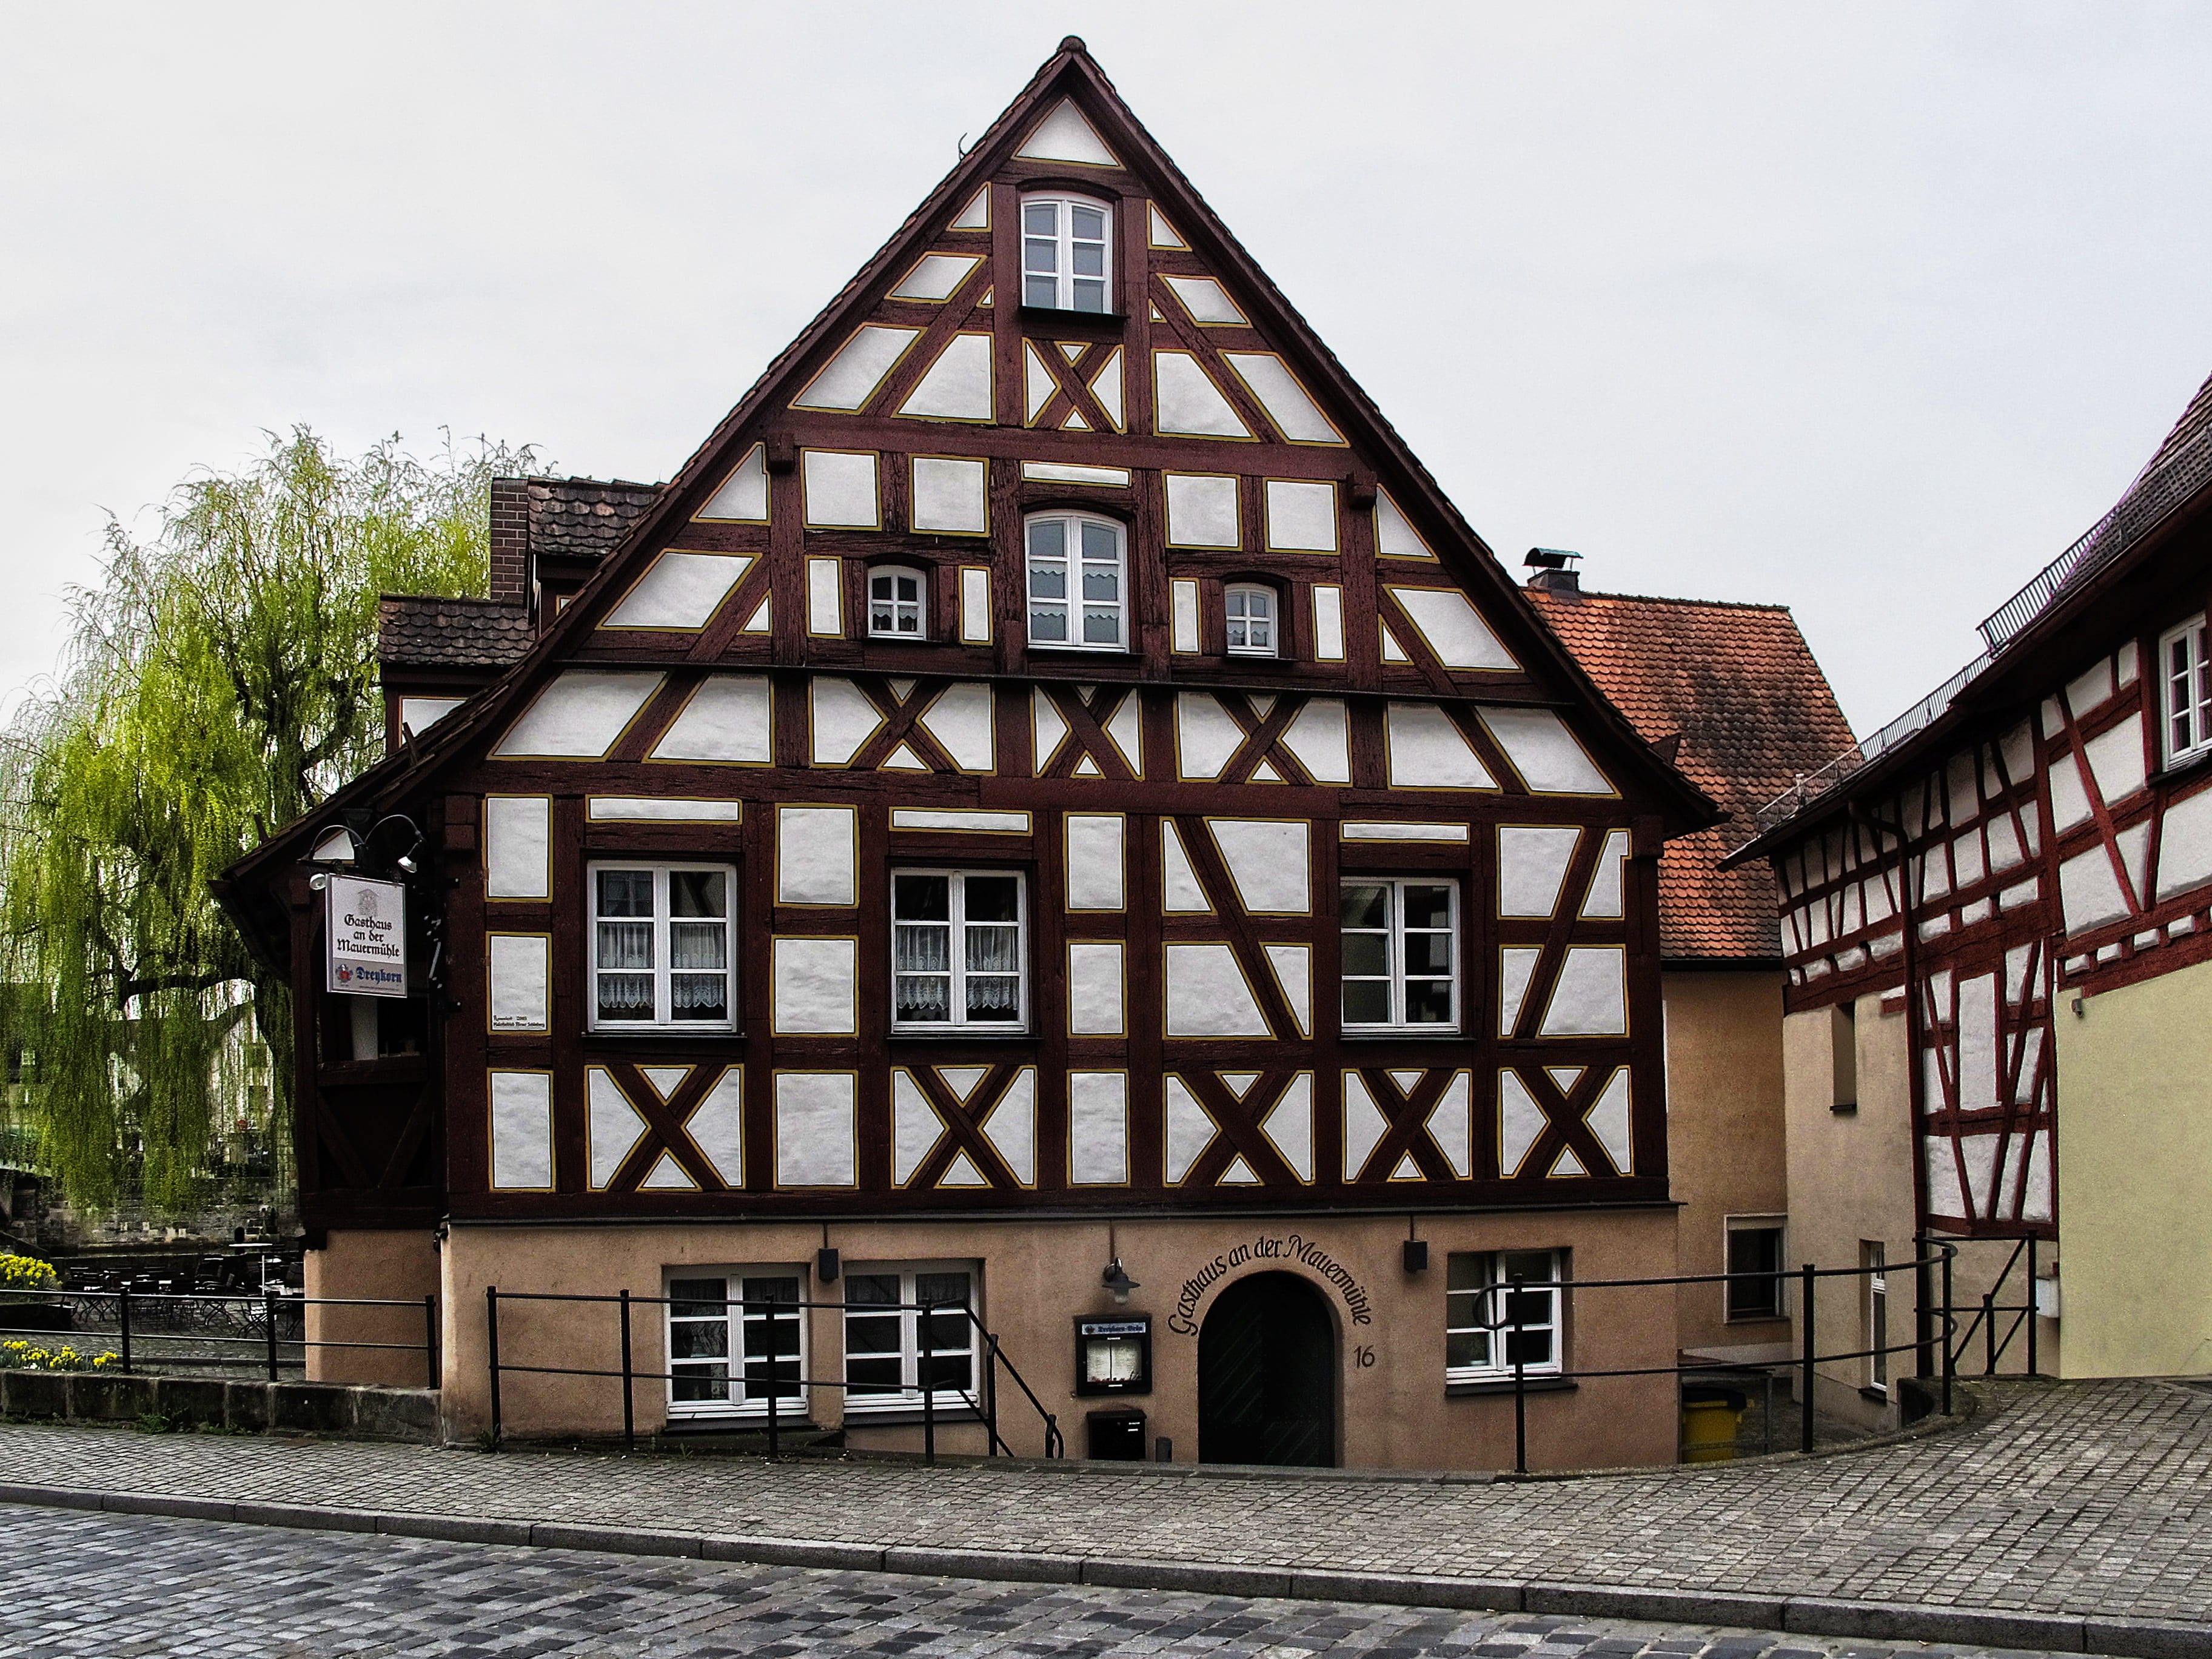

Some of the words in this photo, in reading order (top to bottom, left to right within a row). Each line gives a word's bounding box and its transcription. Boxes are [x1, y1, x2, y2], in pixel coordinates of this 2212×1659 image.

[344, 914, 392, 931] Gasthaus
[354, 931, 365, 940] an
[369, 930, 384, 942] der
[337, 939, 400, 959] Mauermühle
[357, 966, 402, 984] Dreykorn
[1168, 1256, 1227, 1336] Gasthaus
[1228, 1244, 1252, 1267] an
[1254, 1236, 1284, 1258] der
[1283, 1235, 1372, 1326] Mauermühle
[1353, 1345, 1375, 1369] 16
